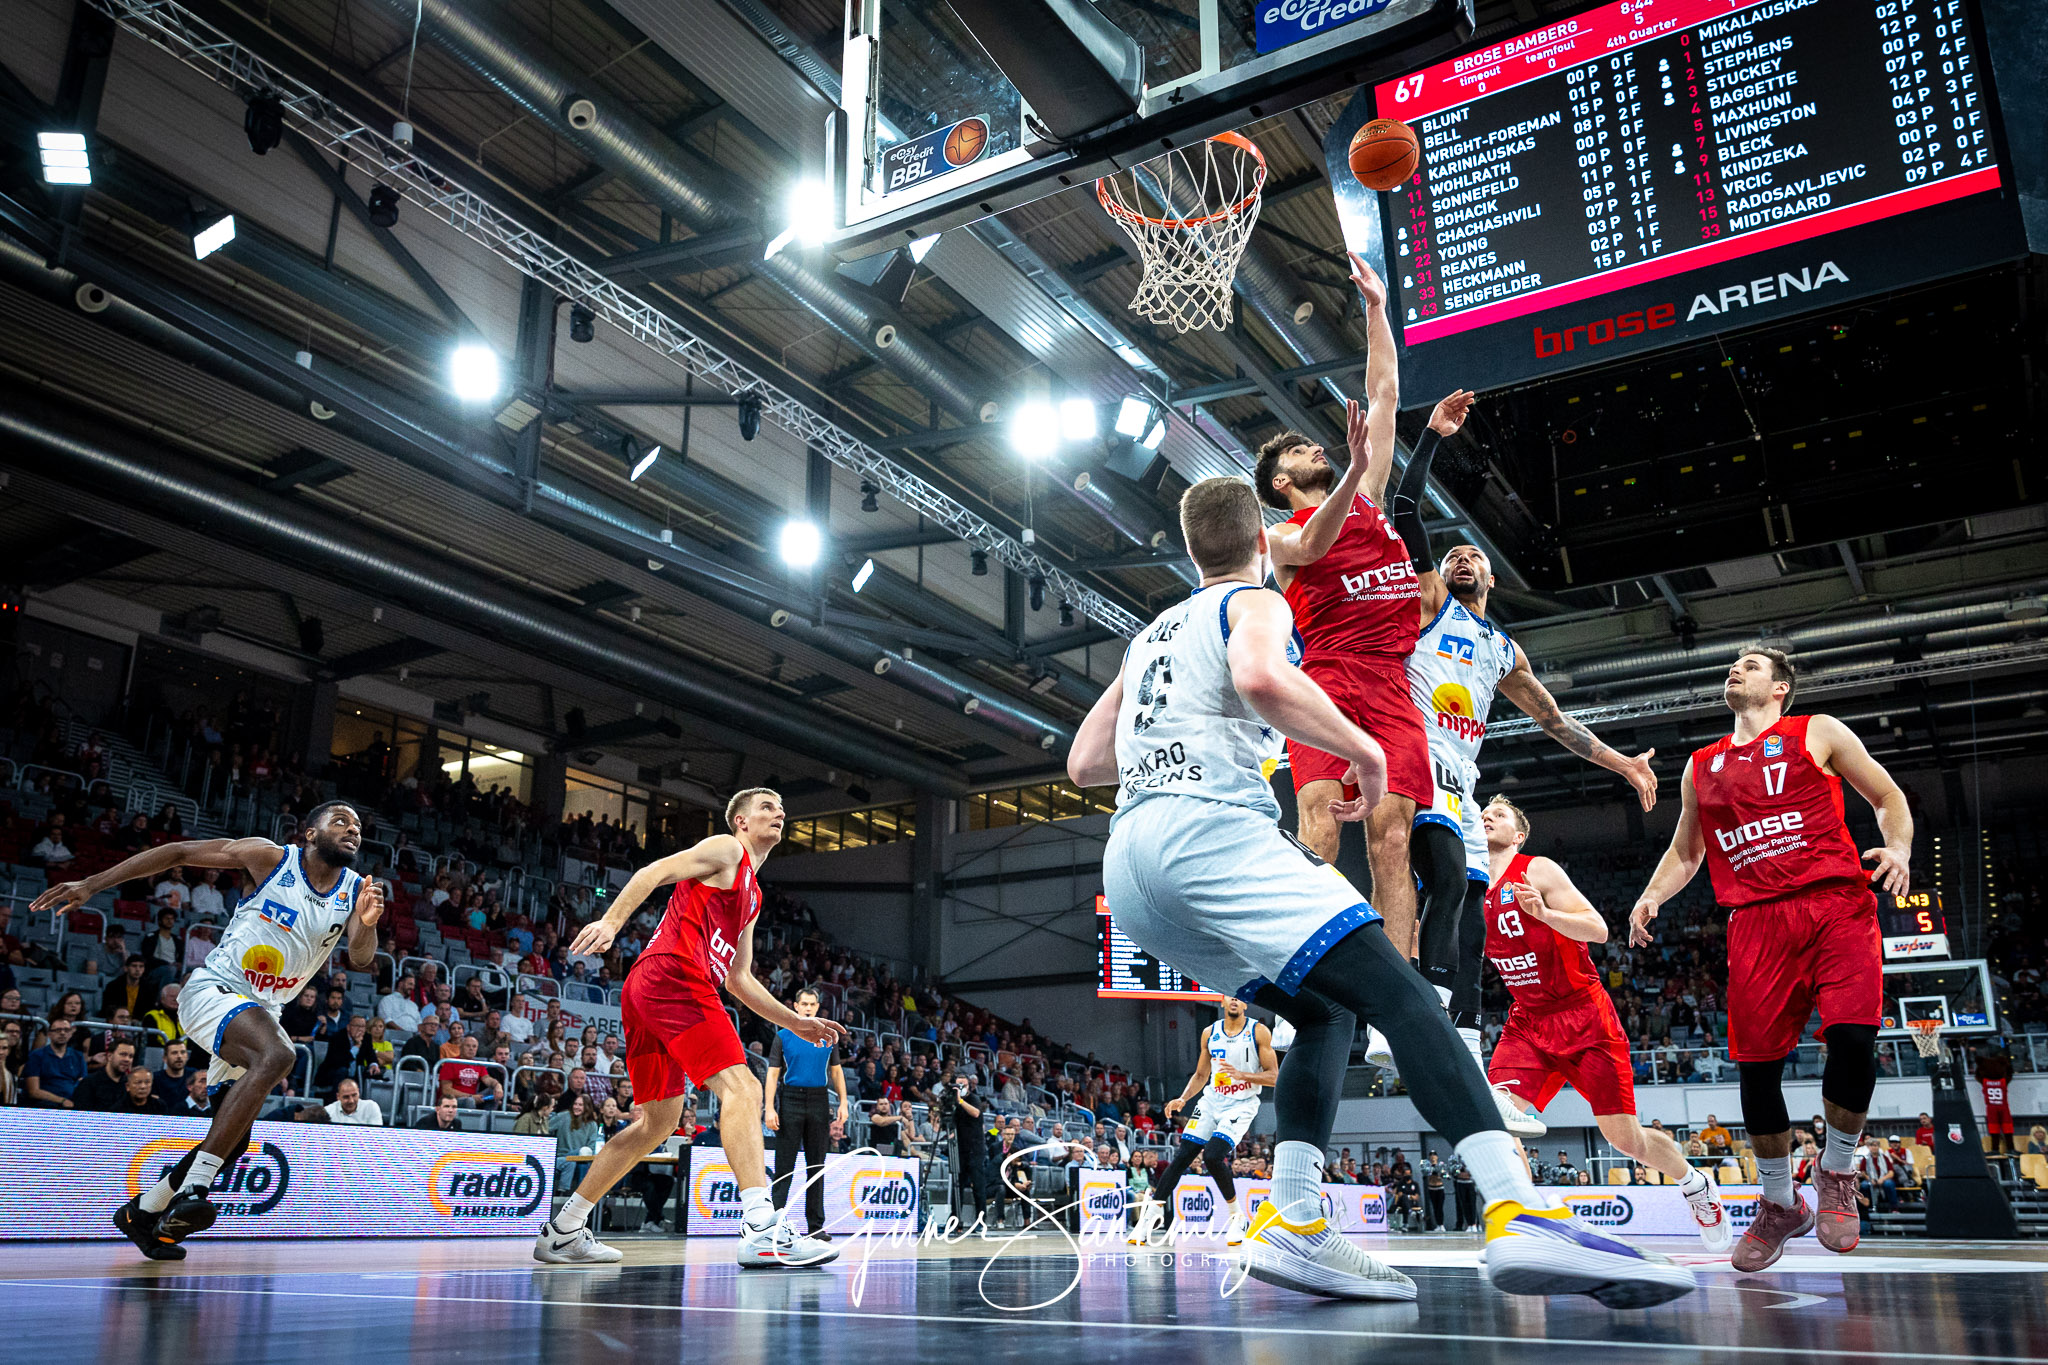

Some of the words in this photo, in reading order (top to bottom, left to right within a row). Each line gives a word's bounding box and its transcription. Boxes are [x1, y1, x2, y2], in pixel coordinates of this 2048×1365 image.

[1606, 34, 1627, 48] 4th
[1629, 18, 1678, 41] Quarter
[1634, 12, 1644, 25] 5
[1454, 47, 1502, 73] BROSE
[1504, 20, 1578, 55] BAMBERG
[1680, 34, 1690, 46] 0
[1683, 51, 1691, 63] 1
[1701, 30, 1754, 58] LEWIS
[1685, 67, 1695, 81] 2
[1703, 35, 1793, 75] STEPHENS
[1875, 2, 1898, 19] 02
[1688, 84, 1698, 98] 3
[1706, 56, 1781, 92] STUCKEY
[1879, 19, 1901, 36] 12
[1932, 6, 1942, 19] 1
[1460, 66, 1501, 87] timeout
[1525, 39, 1575, 64] teamfoul
[1478, 82, 1486, 93] 0
[1547, 58, 1556, 69] 0
[1691, 101, 1701, 114] 4
[1709, 70, 1798, 110] BAGGETTE
[1882, 38, 1904, 55] 00
[1935, 24, 1947, 38] 0
[1394, 74, 1424, 103] 67
[1422, 106, 1470, 134] BLUNT
[1566, 69, 1585, 85] 00
[1610, 56, 1620, 70] 0
[1693, 118, 1703, 132] 5
[1712, 90, 1792, 127] MAXHUNI
[1885, 54, 1906, 73] 07
[1939, 42, 1951, 56] 4
[1695, 135, 1705, 149] 7
[1714, 102, 1816, 144] LIVINGSTON
[1889, 74, 1911, 90] 12
[1942, 60, 1954, 75] 0
[1424, 127, 1462, 149] BELL
[1568, 85, 1586, 101] 01
[1612, 73, 1623, 87] 2
[1424, 110, 1561, 165] WRIGHT-FOREMAN
[1571, 101, 1590, 117] 15
[1615, 90, 1626, 103] 0
[1698, 153, 1708, 167] 9
[1717, 133, 1774, 162] BLECK
[1891, 91, 1914, 109] 04
[1945, 79, 1958, 93] 3
[903, 146, 934, 164] Credit
[1412, 173, 1422, 186] 8
[1427, 136, 1536, 181] KARINIAUSKAS
[1573, 118, 1592, 134] 08
[1618, 107, 1628, 121] 2
[1693, 170, 1710, 186] 11
[1720, 143, 1808, 179] KINDZEKA
[1895, 110, 1918, 127] 03
[1950, 97, 1959, 111] 1
[890, 158, 933, 189] BBL
[1407, 189, 1422, 204] 11
[1429, 160, 1511, 197] WOHLRATH
[1575, 135, 1594, 151] 00
[1620, 123, 1630, 137] 0
[1696, 188, 1715, 204] 13
[1722, 171, 1773, 196] VRCIC
[1898, 128, 1921, 146] 00
[1952, 116, 1965, 130] 0
[1698, 205, 1718, 221] 15
[1726, 163, 1866, 214] RADOSAVLJEVIC
[1902, 147, 1925, 164] 02
[1956, 134, 1968, 149] 0
[1408, 204, 1426, 220] 14
[1431, 176, 1519, 213] SONNEFELD
[1578, 152, 1597, 168] 00
[1622, 140, 1633, 154] 0
[1411, 220, 1427, 236] 17
[1434, 198, 1498, 230] BOHACIK
[1581, 168, 1598, 184] 11
[1625, 157, 1636, 171] 3
[1700, 223, 1720, 239] 33
[1728, 192, 1831, 232] MIDTGAARD
[1905, 165, 1927, 182] 09
[1960, 153, 1972, 167] 4
[1412, 237, 1428, 253] 21
[1436, 203, 1541, 245] CHACHASHVILI
[1582, 184, 1602, 201] 05
[1628, 174, 1637, 188] 1
[1414, 253, 1432, 269] 22
[1437, 236, 1488, 261] YOUNG
[1585, 201, 1604, 218] 07
[1630, 191, 1641, 206] 2
[1416, 269, 1432, 284] 31
[1440, 250, 1497, 278] REAVES
[1587, 219, 1607, 235] 03
[1633, 208, 1642, 222] 1
[1418, 285, 1436, 301] 33
[1442, 259, 1526, 294] HECKMANN
[1590, 236, 1610, 252] 02
[1636, 225, 1645, 239] 1
[1420, 302, 1438, 316] 43
[1444, 273, 1542, 311] SENGFELDER
[1593, 252, 1612, 269] 15
[1639, 243, 1647, 256] 1
[1533, 302, 1676, 359] brose
[1686, 260, 1850, 322] ARENA
[1340, 560, 1417, 594] brose
[1393, 582, 1419, 591] Partner
[1437, 712, 1486, 742] nippo
[1762, 761, 1788, 796] 17
[1714, 811, 1804, 852] brose
[1770, 834, 1802, 847] Partner
[321, 923, 343, 948] 2
[1497, 910, 1525, 939] 43
[1917, 911, 1933, 932] 5
[1490, 952, 1538, 972] rose
[245, 968, 304, 993] nippo
[524, 1001, 582, 1029] brse
[588, 1016, 625, 1034] ARE
[1214, 1080, 1252, 1095] nippon
[1987, 1087, 2003, 1101] 99
[448, 1166, 533, 1197] radio
[861, 1181, 909, 1205] radio
[1089, 1188, 1119, 1209] radio
[453, 1205, 517, 1217] BAMBERG
[1182, 1193, 1210, 1211] radio
[1364, 1200, 1382, 1215] radio
[1573, 1201, 1624, 1217] radio
[1723, 1202, 1757, 1217] rad
